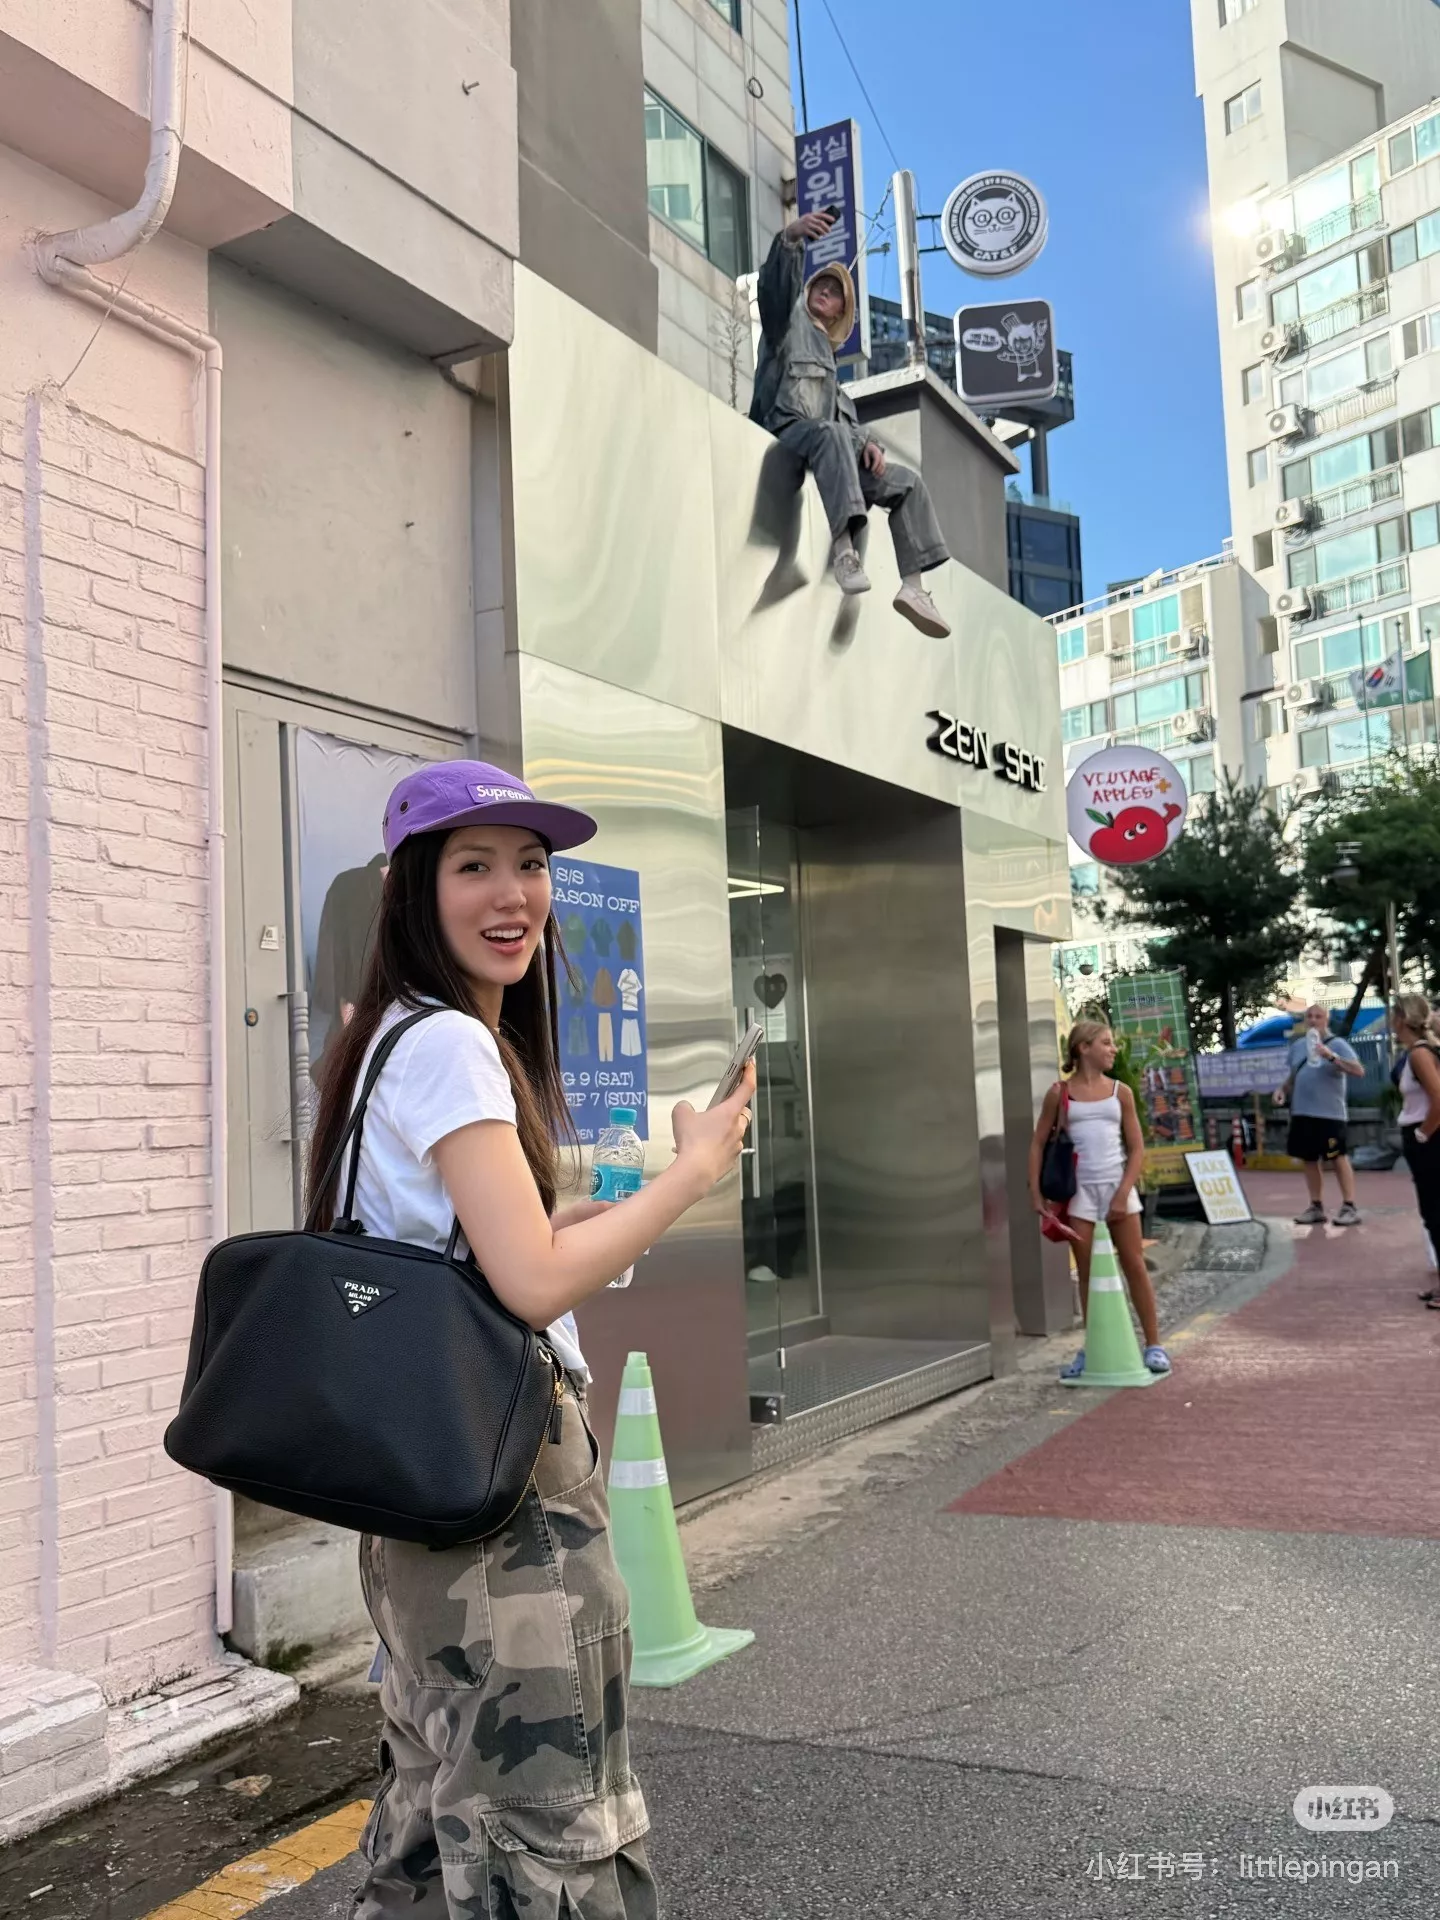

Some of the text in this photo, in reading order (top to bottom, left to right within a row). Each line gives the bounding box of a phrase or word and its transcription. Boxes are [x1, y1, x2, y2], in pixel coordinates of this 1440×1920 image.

[800, 132, 848, 170] 성실
[937, 709, 1048, 792] ZEN SAI
[1092, 786, 1153, 805] APPLES
[556, 867, 584, 885] S/S
[553, 887, 639, 913] ASON OFF
[561, 1070, 634, 1088] G 9 (SAT)
[565, 1090, 647, 1108] EP 7 (SUN)
[1194, 1160, 1230, 1174] TAKE
[1200, 1176, 1235, 1196] OUT
[344, 1281, 380, 1296] PRADA
[348, 1291, 372, 1302] MILANO
